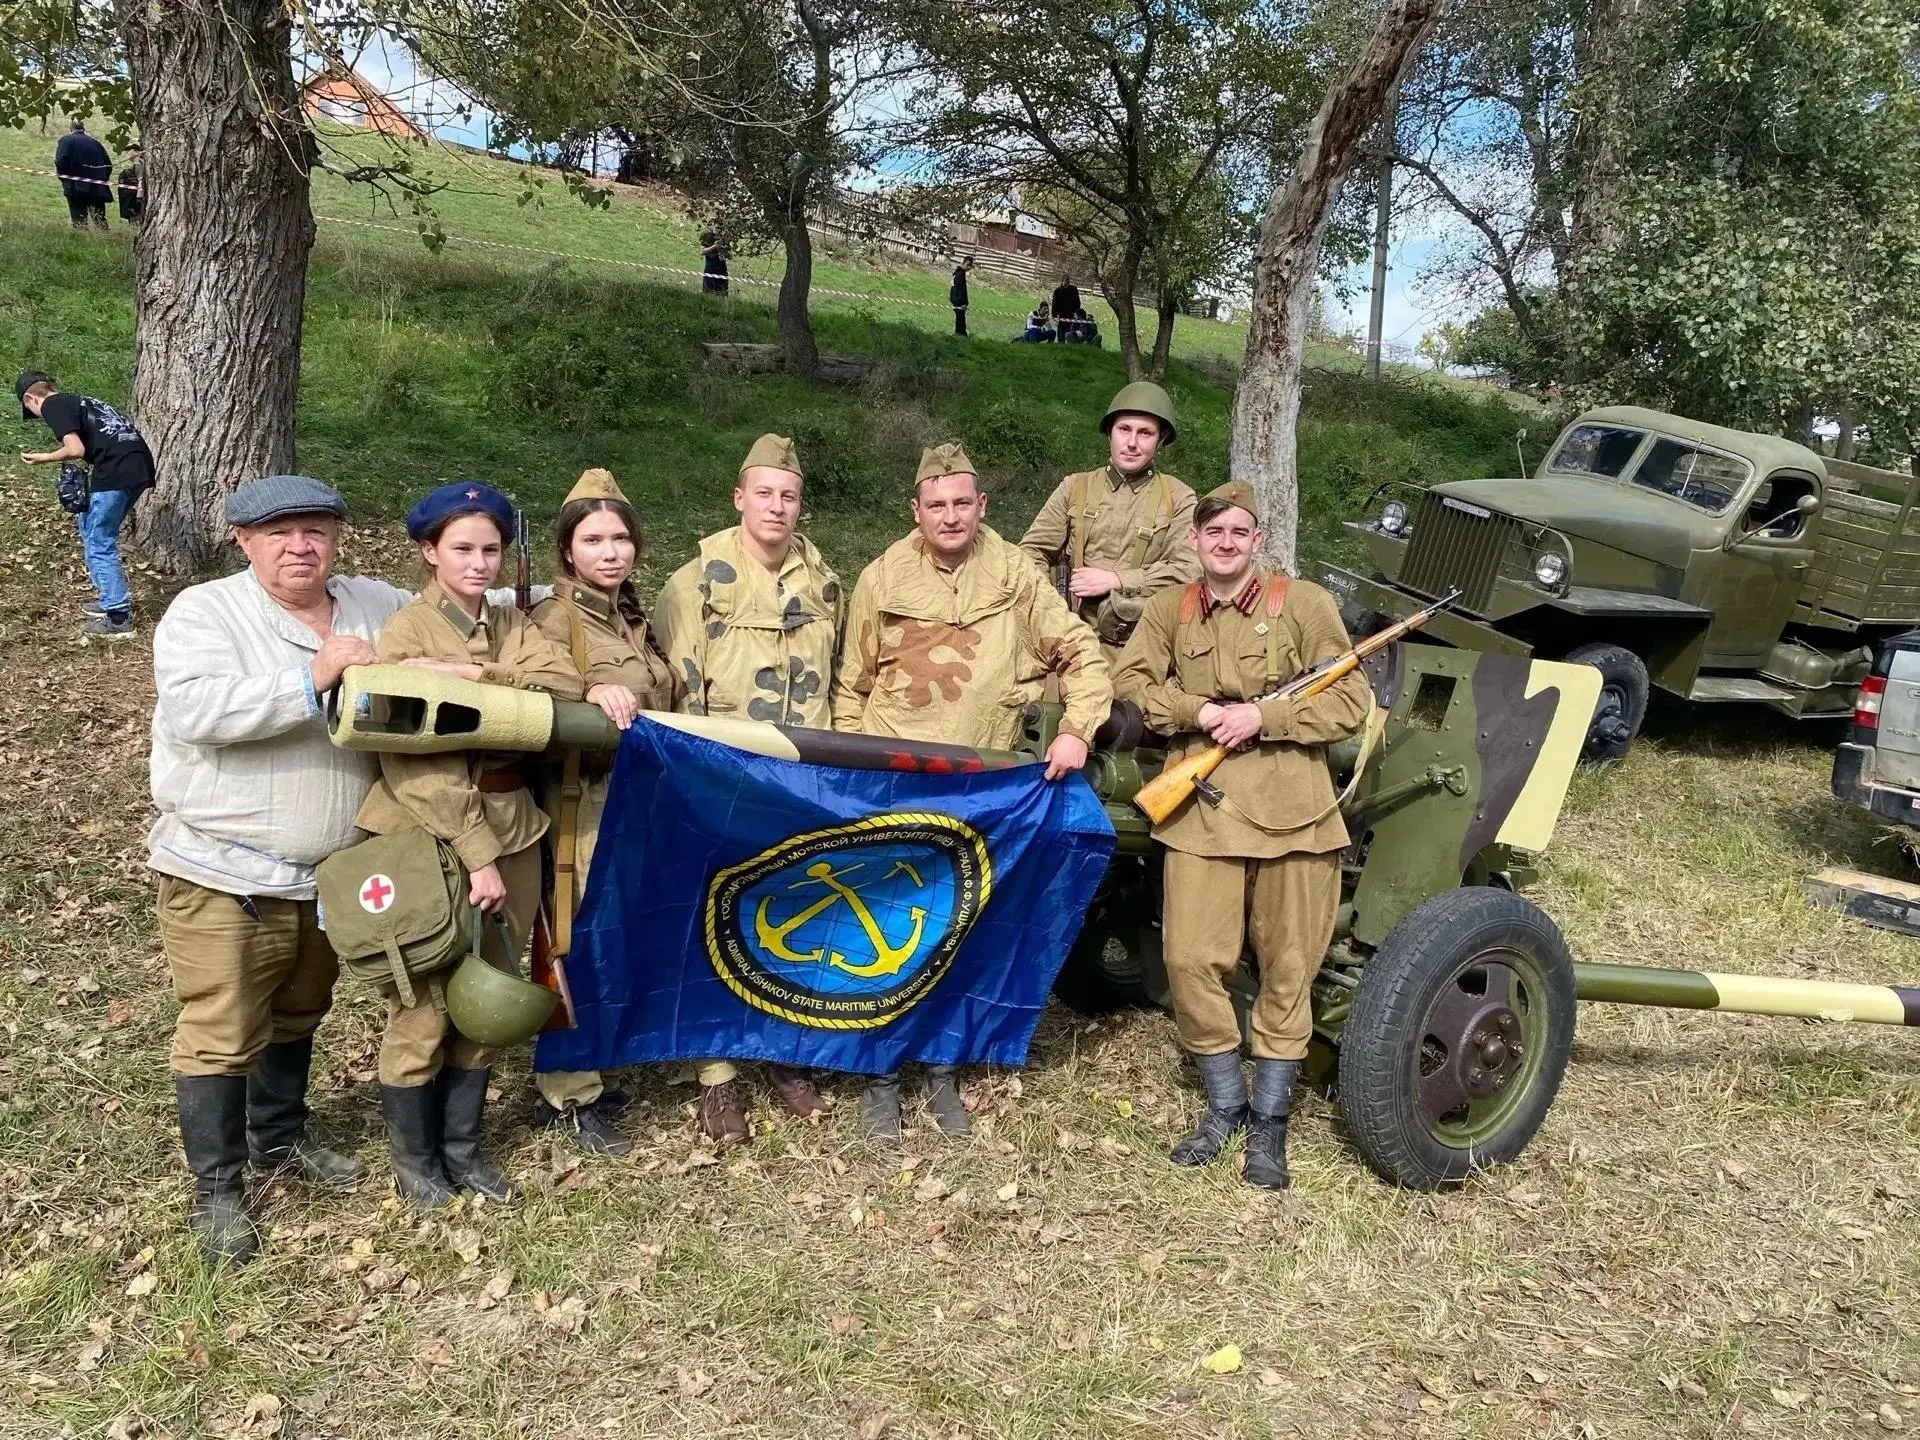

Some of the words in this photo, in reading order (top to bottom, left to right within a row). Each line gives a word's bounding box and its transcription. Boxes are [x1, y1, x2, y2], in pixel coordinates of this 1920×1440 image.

[788, 837, 849, 861] МОРСКОЙ
[852, 831, 934, 843] УНИВЕРСИТЕТ
[726, 939, 750, 977] ADMIRAL
[750, 971, 793, 1001] USHAKOV
[791, 994, 824, 1010] STATE
[825, 1001, 877, 1012] MARITIME
[877, 969, 932, 1009] UNIVERSITY
